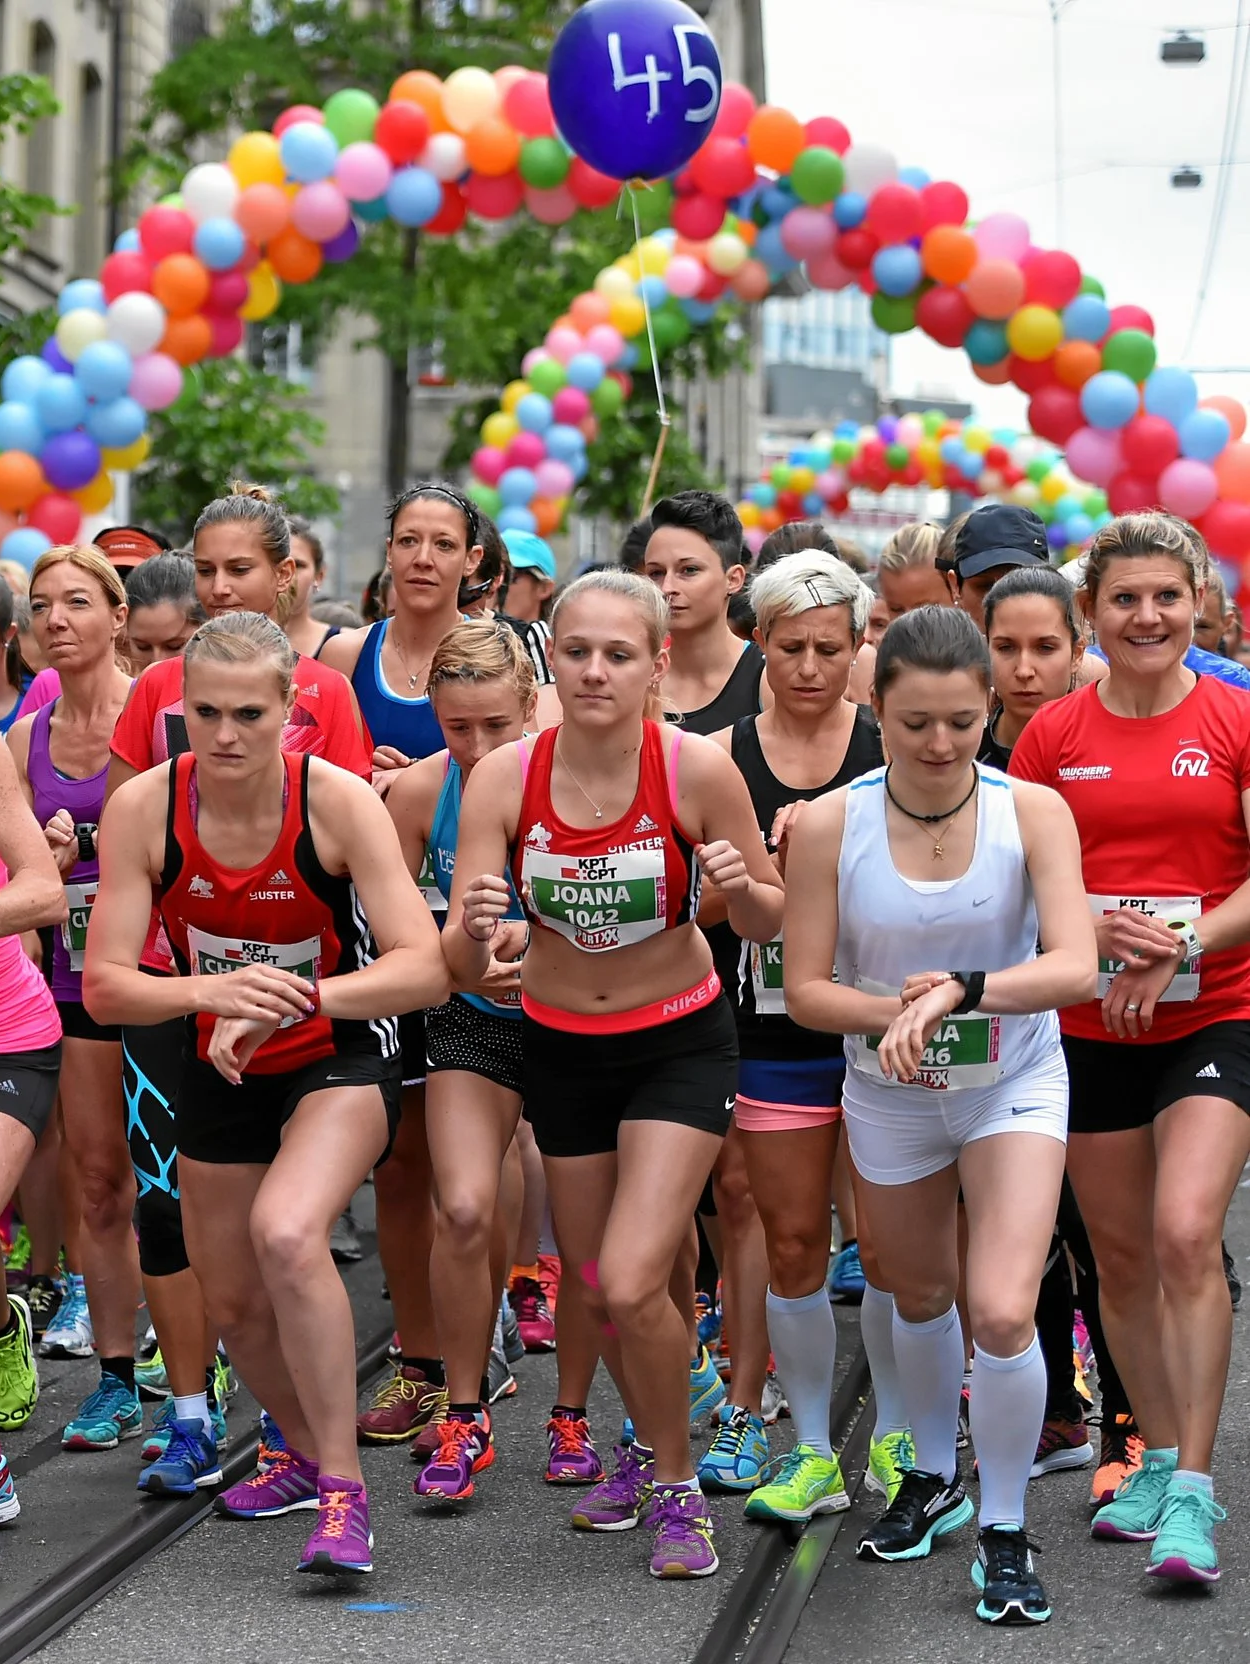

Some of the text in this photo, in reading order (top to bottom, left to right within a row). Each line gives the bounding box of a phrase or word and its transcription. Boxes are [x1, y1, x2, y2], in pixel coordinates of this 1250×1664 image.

[607, 24, 720, 124] 45
[1058, 766, 1105, 776] VAUCHER
[633, 824, 659, 834] adidas
[578, 857, 609, 870] KPT
[587, 867, 618, 881] CPT
[550, 884, 632, 906] JOANA
[564, 908, 620, 928] 1042
[242, 942, 271, 955] KPT
[251, 952, 279, 965] CPT
[662, 985, 707, 1016] NIKE
